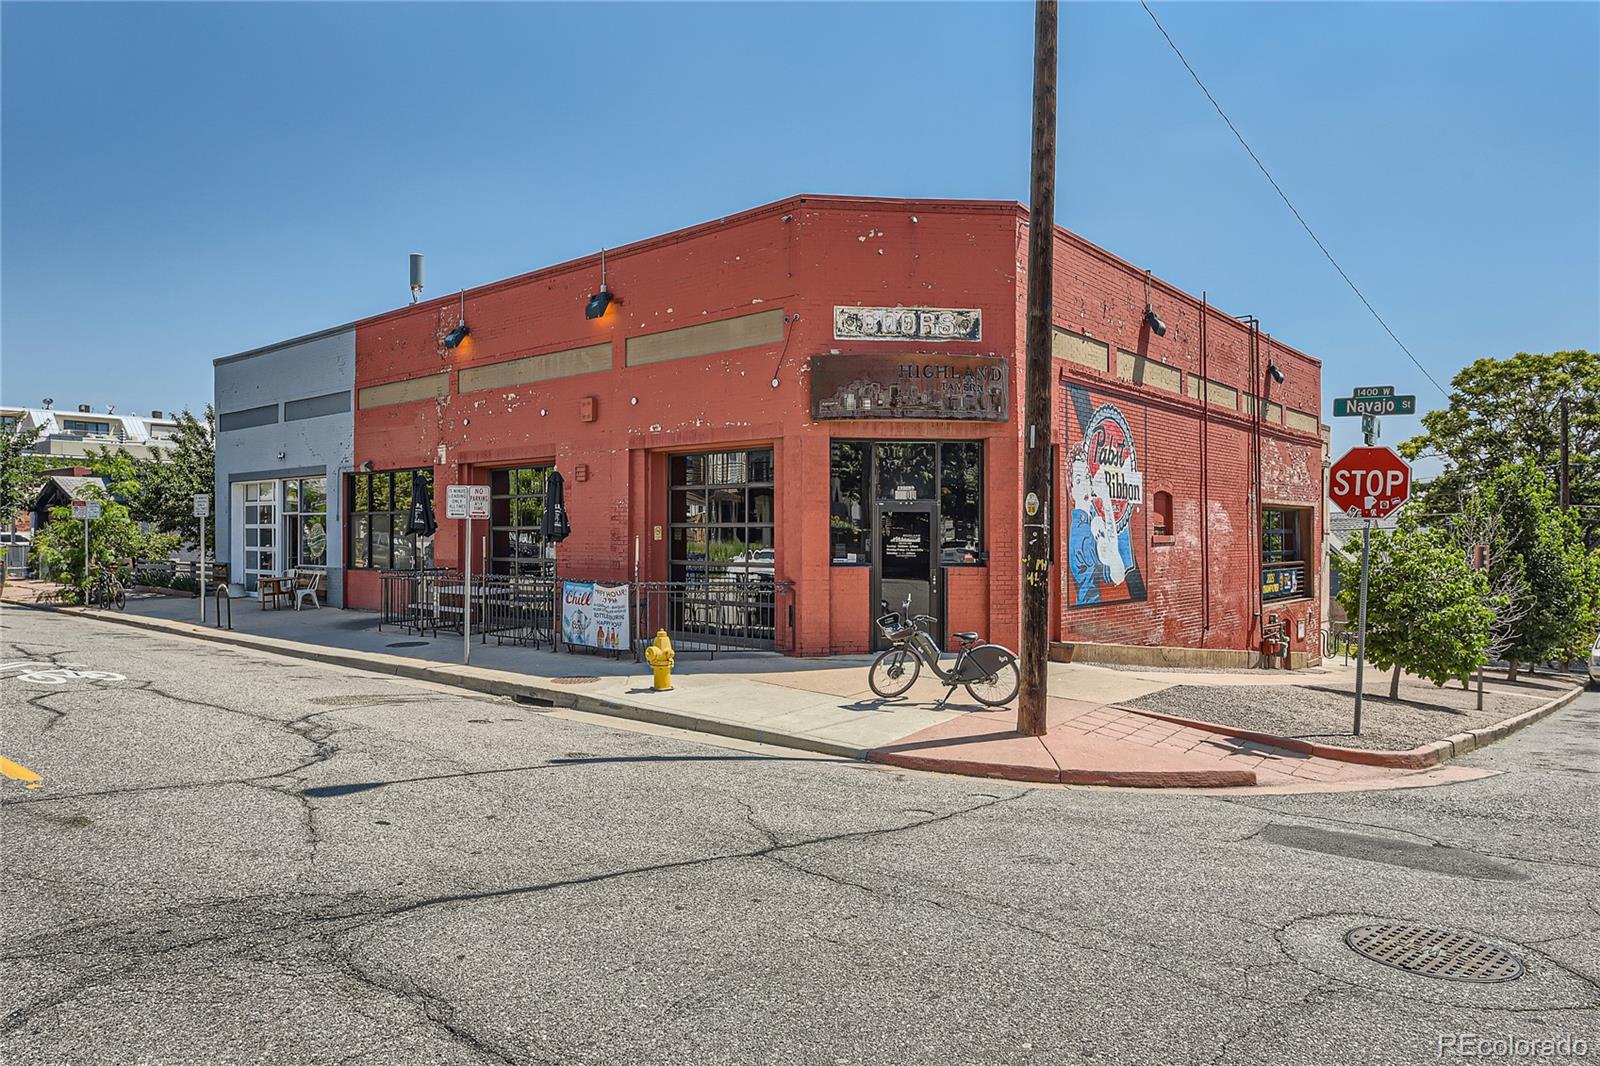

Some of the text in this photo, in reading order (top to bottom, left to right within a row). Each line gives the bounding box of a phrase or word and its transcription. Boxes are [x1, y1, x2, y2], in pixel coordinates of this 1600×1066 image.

[898, 364, 1002, 381] HIGHLAND
[942, 382, 984, 392] TAVERN
[1357, 388, 1391, 396] 1400 W
[1346, 398, 1411, 415] Navajo St
[1092, 425, 1126, 468] Pabst
[1104, 470, 1141, 501] Ribbon
[1333, 469, 1404, 497] STOP
[566, 591, 593, 606] Chill
